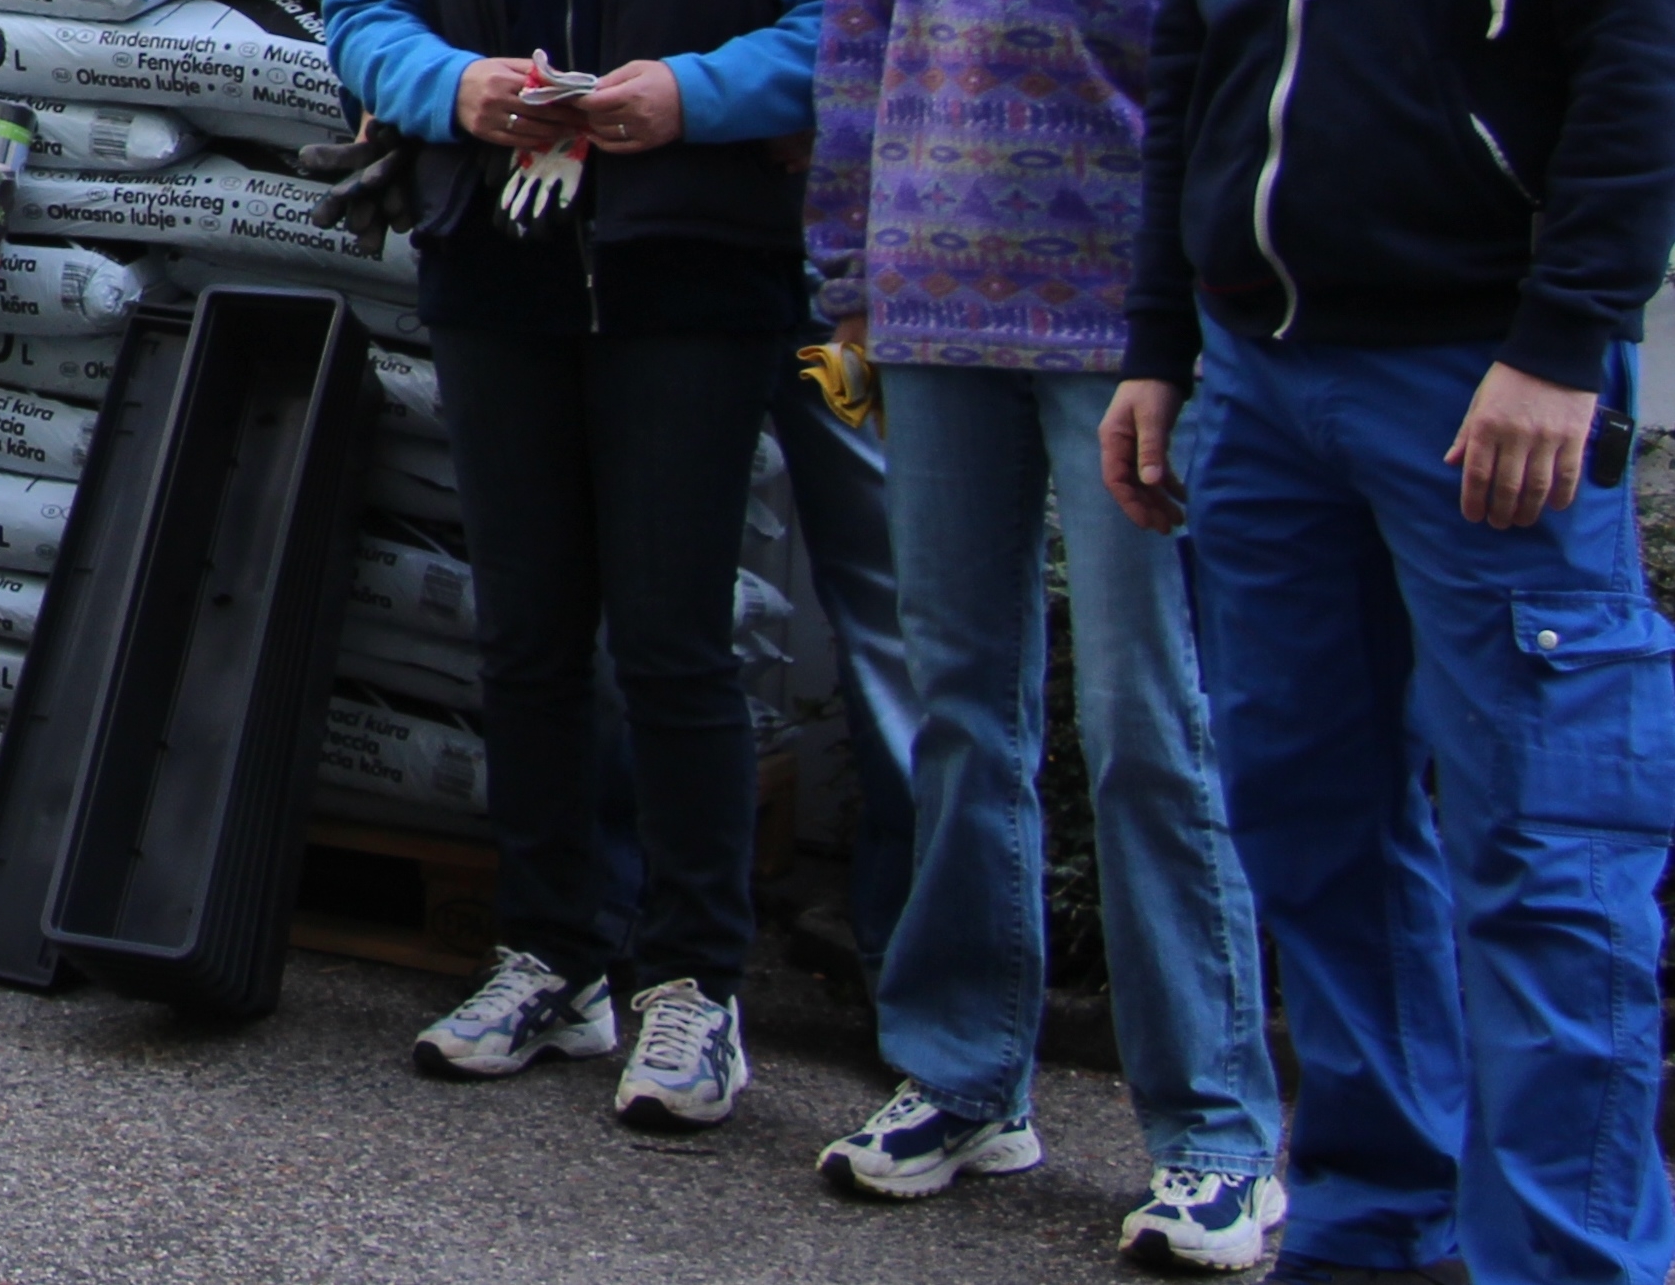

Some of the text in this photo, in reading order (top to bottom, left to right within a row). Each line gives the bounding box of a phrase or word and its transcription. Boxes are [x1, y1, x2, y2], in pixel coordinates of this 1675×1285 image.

[99, 29, 217, 54] Rindenmulch
[15, 49, 28, 72] L
[138, 52, 245, 83] Fenyőkéreg
[76, 67, 151, 89] Okrasno
[156, 74, 201, 96] lubje
[113, 186, 225, 215] Fenyőkéreg
[47, 204, 124, 224] Okrasno
[130, 208, 176, 231] lubje
[231, 218, 335, 252] Mulčovacia
[1, 295, 39, 315] kôra
[21, 343, 34, 366] L
[6, 438, 45, 462] kôra
[1, 666, 13, 690] L
